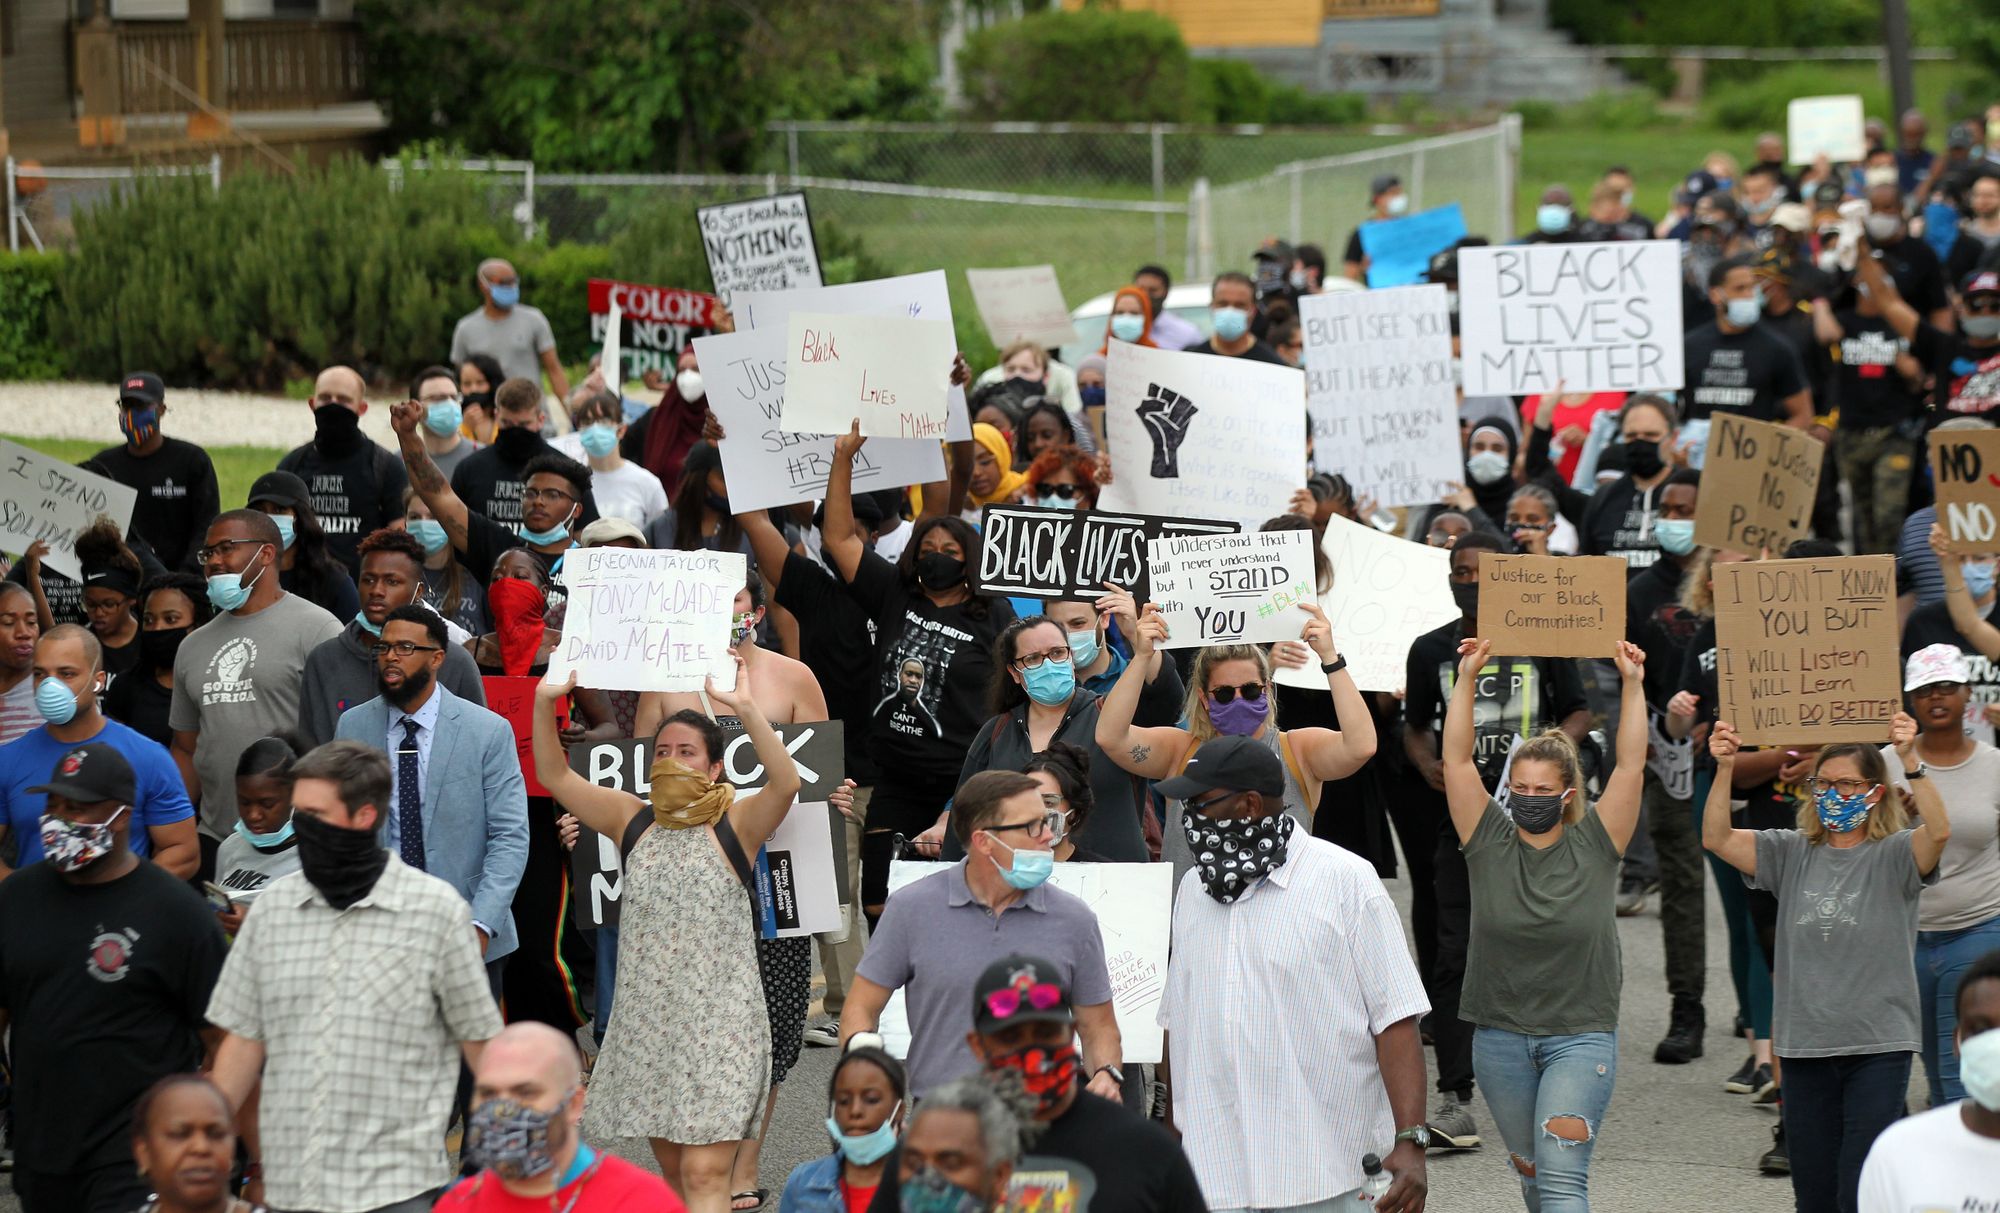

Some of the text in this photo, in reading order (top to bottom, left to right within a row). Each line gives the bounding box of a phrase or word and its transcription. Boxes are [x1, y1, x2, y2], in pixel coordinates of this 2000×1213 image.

[706, 223, 805, 265] NOTHING
[1493, 246, 1648, 298] BLACK
[608, 284, 706, 323] COLOR
[632, 320, 692, 353] NOT
[1307, 316, 1350, 346] BUT
[1367, 313, 1407, 340] SEE
[1408, 312, 1448, 337] YOU
[1500, 297, 1653, 345] LIVES
[801, 329, 839, 363] Black
[728, 358, 786, 400] JUS
[1309, 367, 1341, 394] BUT
[1360, 363, 1415, 389] HEAR
[1418, 360, 1452, 386] YOU
[1480, 344, 1667, 392] MATTER
[1312, 416, 1350, 438] BUT
[1373, 407, 1443, 430] MOURN
[1717, 420, 1756, 460] No
[786, 448, 871, 484] #BM
[1939, 444, 1982, 483] NO
[8, 456, 107, 511] I STAND
[1759, 472, 1785, 510] No
[317, 517, 362, 533] TALITY
[1947, 502, 1996, 542] NO
[588, 552, 720, 573] BREONNA TAYLOR
[980, 514, 1145, 586] BLACK LIVES
[1155, 541, 1160, 560] I
[1258, 533, 1287, 547] that
[1297, 532, 1301, 544] I
[1151, 552, 1281, 575] will never understand
[1491, 560, 1577, 586] Justice for
[577, 584, 645, 618] TONY
[644, 580, 729, 614] McDADE
[1156, 580, 1175, 592] but
[1188, 577, 1193, 590] I
[1256, 580, 1311, 620] #BLM
[1520, 590, 1603, 606] our Black
[1731, 565, 1892, 604] I DON'T KNOW
[941, 627, 974, 642] MATTER
[1505, 608, 1603, 630] Communities!
[1759, 607, 1883, 638] YOU BUT
[624, 626, 713, 671] McATEE
[1721, 648, 1733, 675] I
[1747, 650, 1790, 674] WILL
[203, 678, 253, 693] SOUTH
[203, 691, 256, 706] AFRICA
[1726, 679, 1735, 705] I
[1750, 679, 1791, 700] WILL
[893, 711, 917, 724] CAN'T
[902, 703, 906, 711] I
[1731, 708, 1741, 733] I
[1752, 706, 1791, 730] WILL
[1799, 703, 1824, 722] DO
[890, 719, 923, 736] BREATHE
[590, 728, 819, 794] BLCK
[222, 869, 271, 890] NIKE
[761, 872, 772, 908] without the
[771, 869, 786, 911] goodness
[779, 859, 795, 921] Crispy, golden
[1109, 957, 1143, 985] POLICE
[1112, 963, 1158, 997] BRUTALITY
